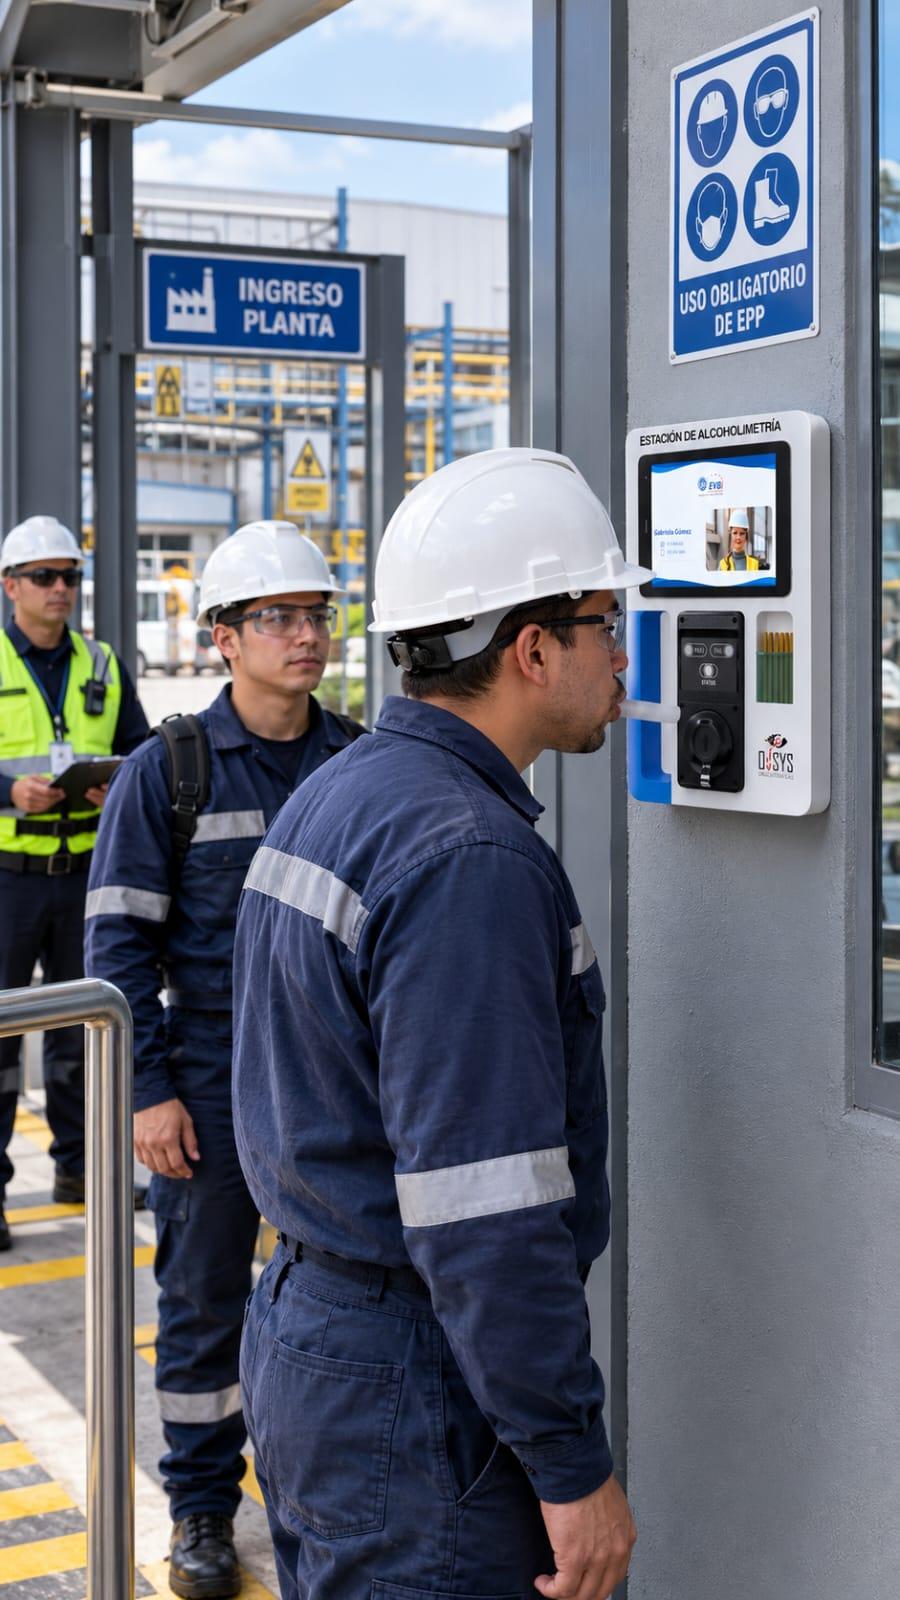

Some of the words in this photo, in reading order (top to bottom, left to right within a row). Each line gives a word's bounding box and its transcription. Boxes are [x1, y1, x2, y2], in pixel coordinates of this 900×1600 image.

[239, 277, 343, 308] INGRESO
[679, 288, 707, 315] USO
[710, 263, 806, 308] OBLIGATORIO
[243, 308, 335, 338] PLANTA
[715, 311, 733, 337] DE
[737, 304, 765, 333] EPP
[639, 429, 682, 447] ESTACIÓN
[684, 430, 697, 441] DE
[697, 418, 782, 440] ALCOHOLIMETRÍA
